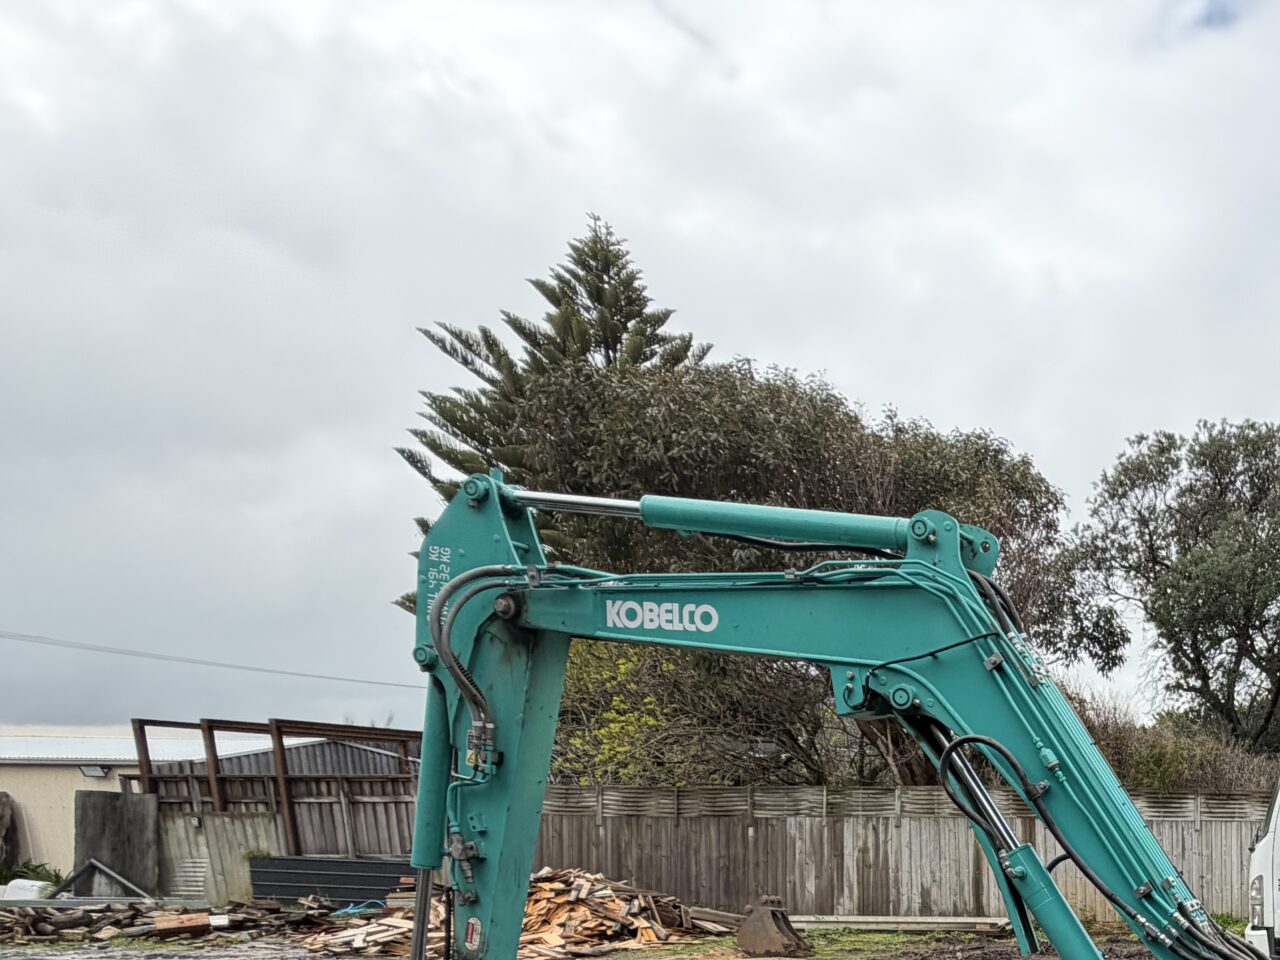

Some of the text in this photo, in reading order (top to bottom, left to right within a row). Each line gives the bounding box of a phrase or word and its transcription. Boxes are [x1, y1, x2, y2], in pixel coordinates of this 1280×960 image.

[428, 545, 440, 561] KG
[440, 547, 451, 562] KG
[427, 567, 438, 588] 491
[606, 600, 719, 633] KOBELCO
